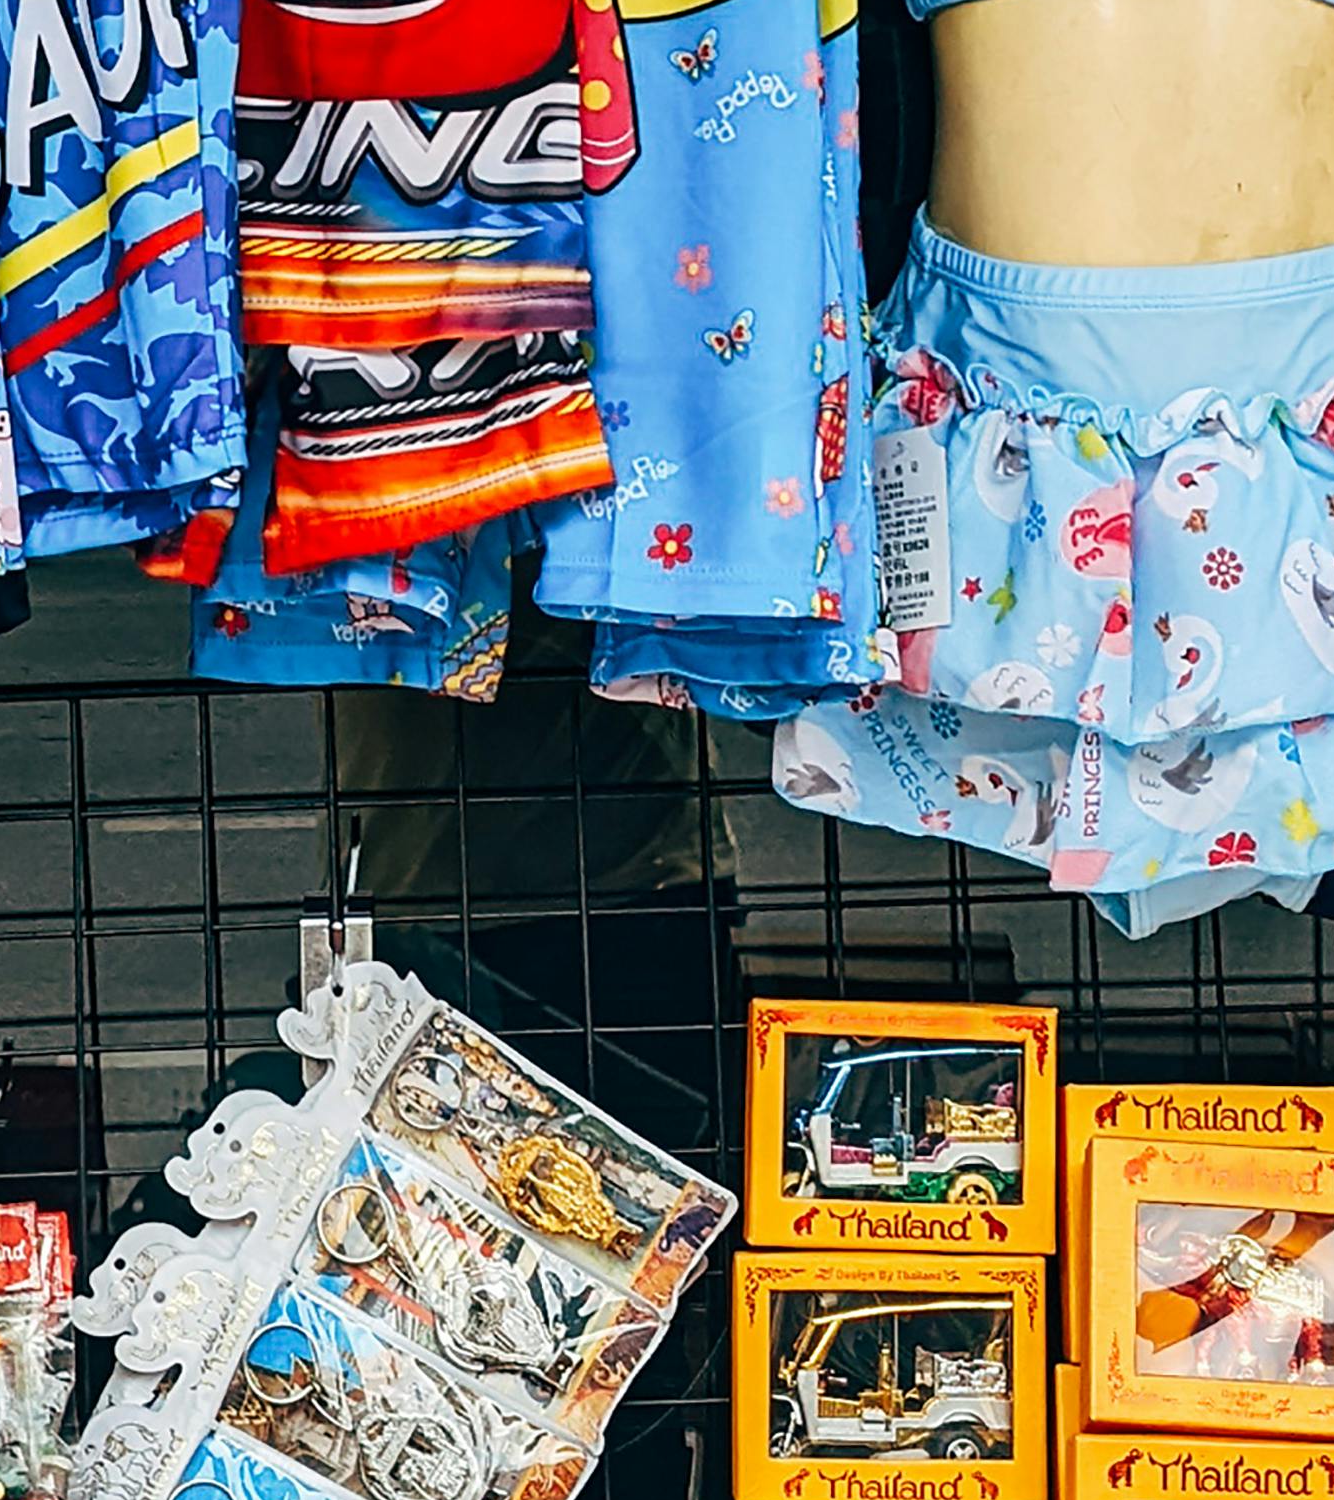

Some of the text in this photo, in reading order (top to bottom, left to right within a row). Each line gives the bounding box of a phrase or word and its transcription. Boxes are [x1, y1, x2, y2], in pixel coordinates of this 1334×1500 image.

[715, 69, 798, 118] Peppa
[235, 80, 581, 201] ING
[573, 480, 646, 522] Peppa
[862, 710, 937, 815] PRINCESS
[891, 714, 949, 783] SWEET
[1132, 1095, 1287, 1132] Thailand
[828, 1208, 971, 1241] Thailand
[818, 1469, 962, 1500] Thailand
[1146, 1454, 1315, 1496] Thailand
